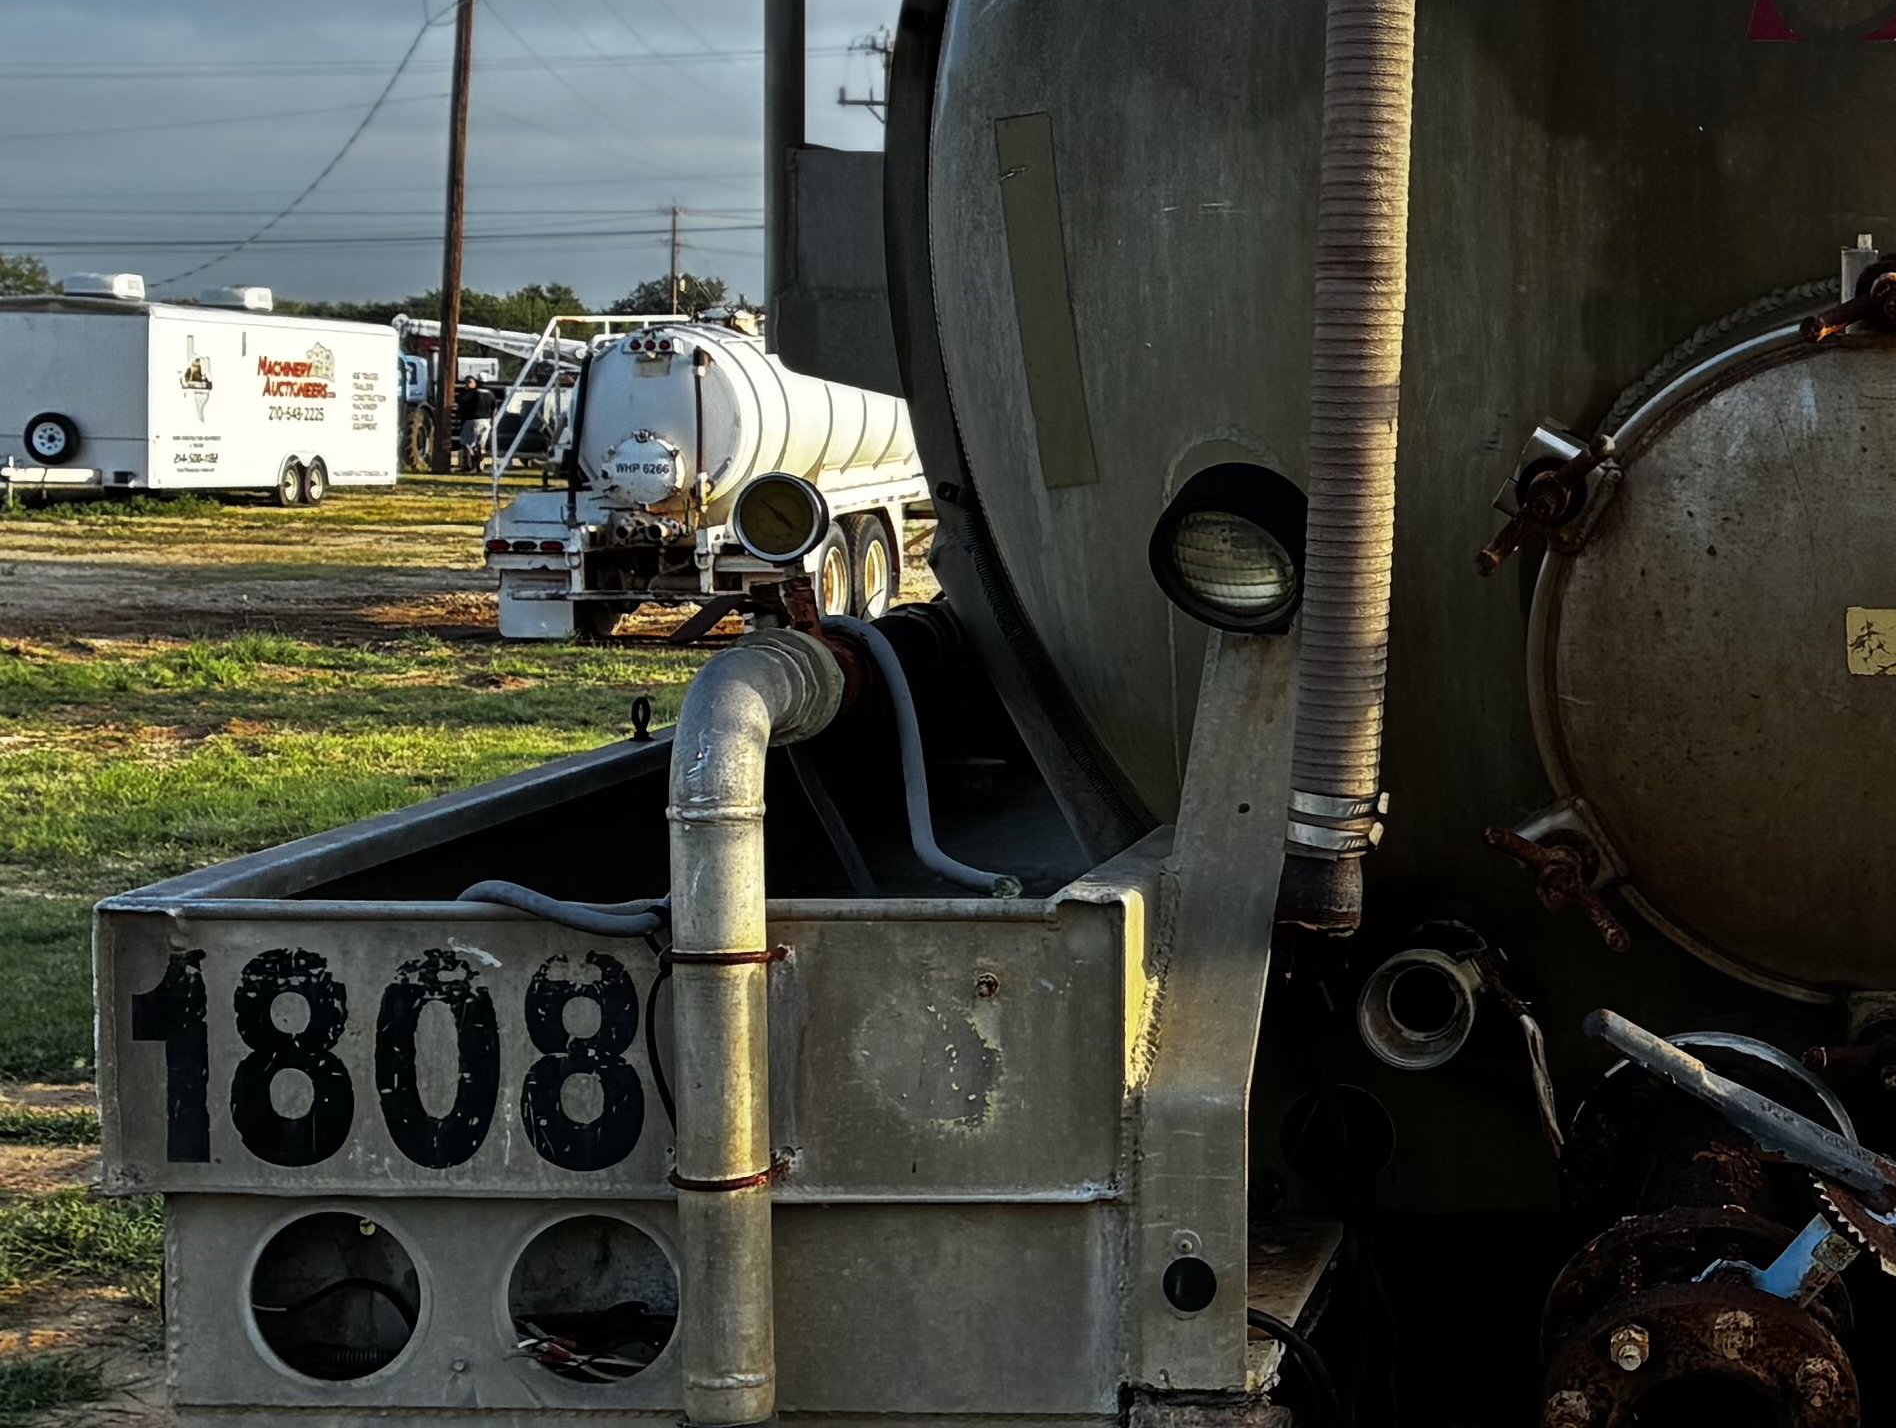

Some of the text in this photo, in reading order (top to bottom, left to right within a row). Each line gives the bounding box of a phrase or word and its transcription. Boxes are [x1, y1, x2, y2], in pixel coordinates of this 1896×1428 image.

[257, 355, 313, 378] MACHINERY
[616, 462, 640, 474] WHP
[132, 948, 646, 1172] 1808
